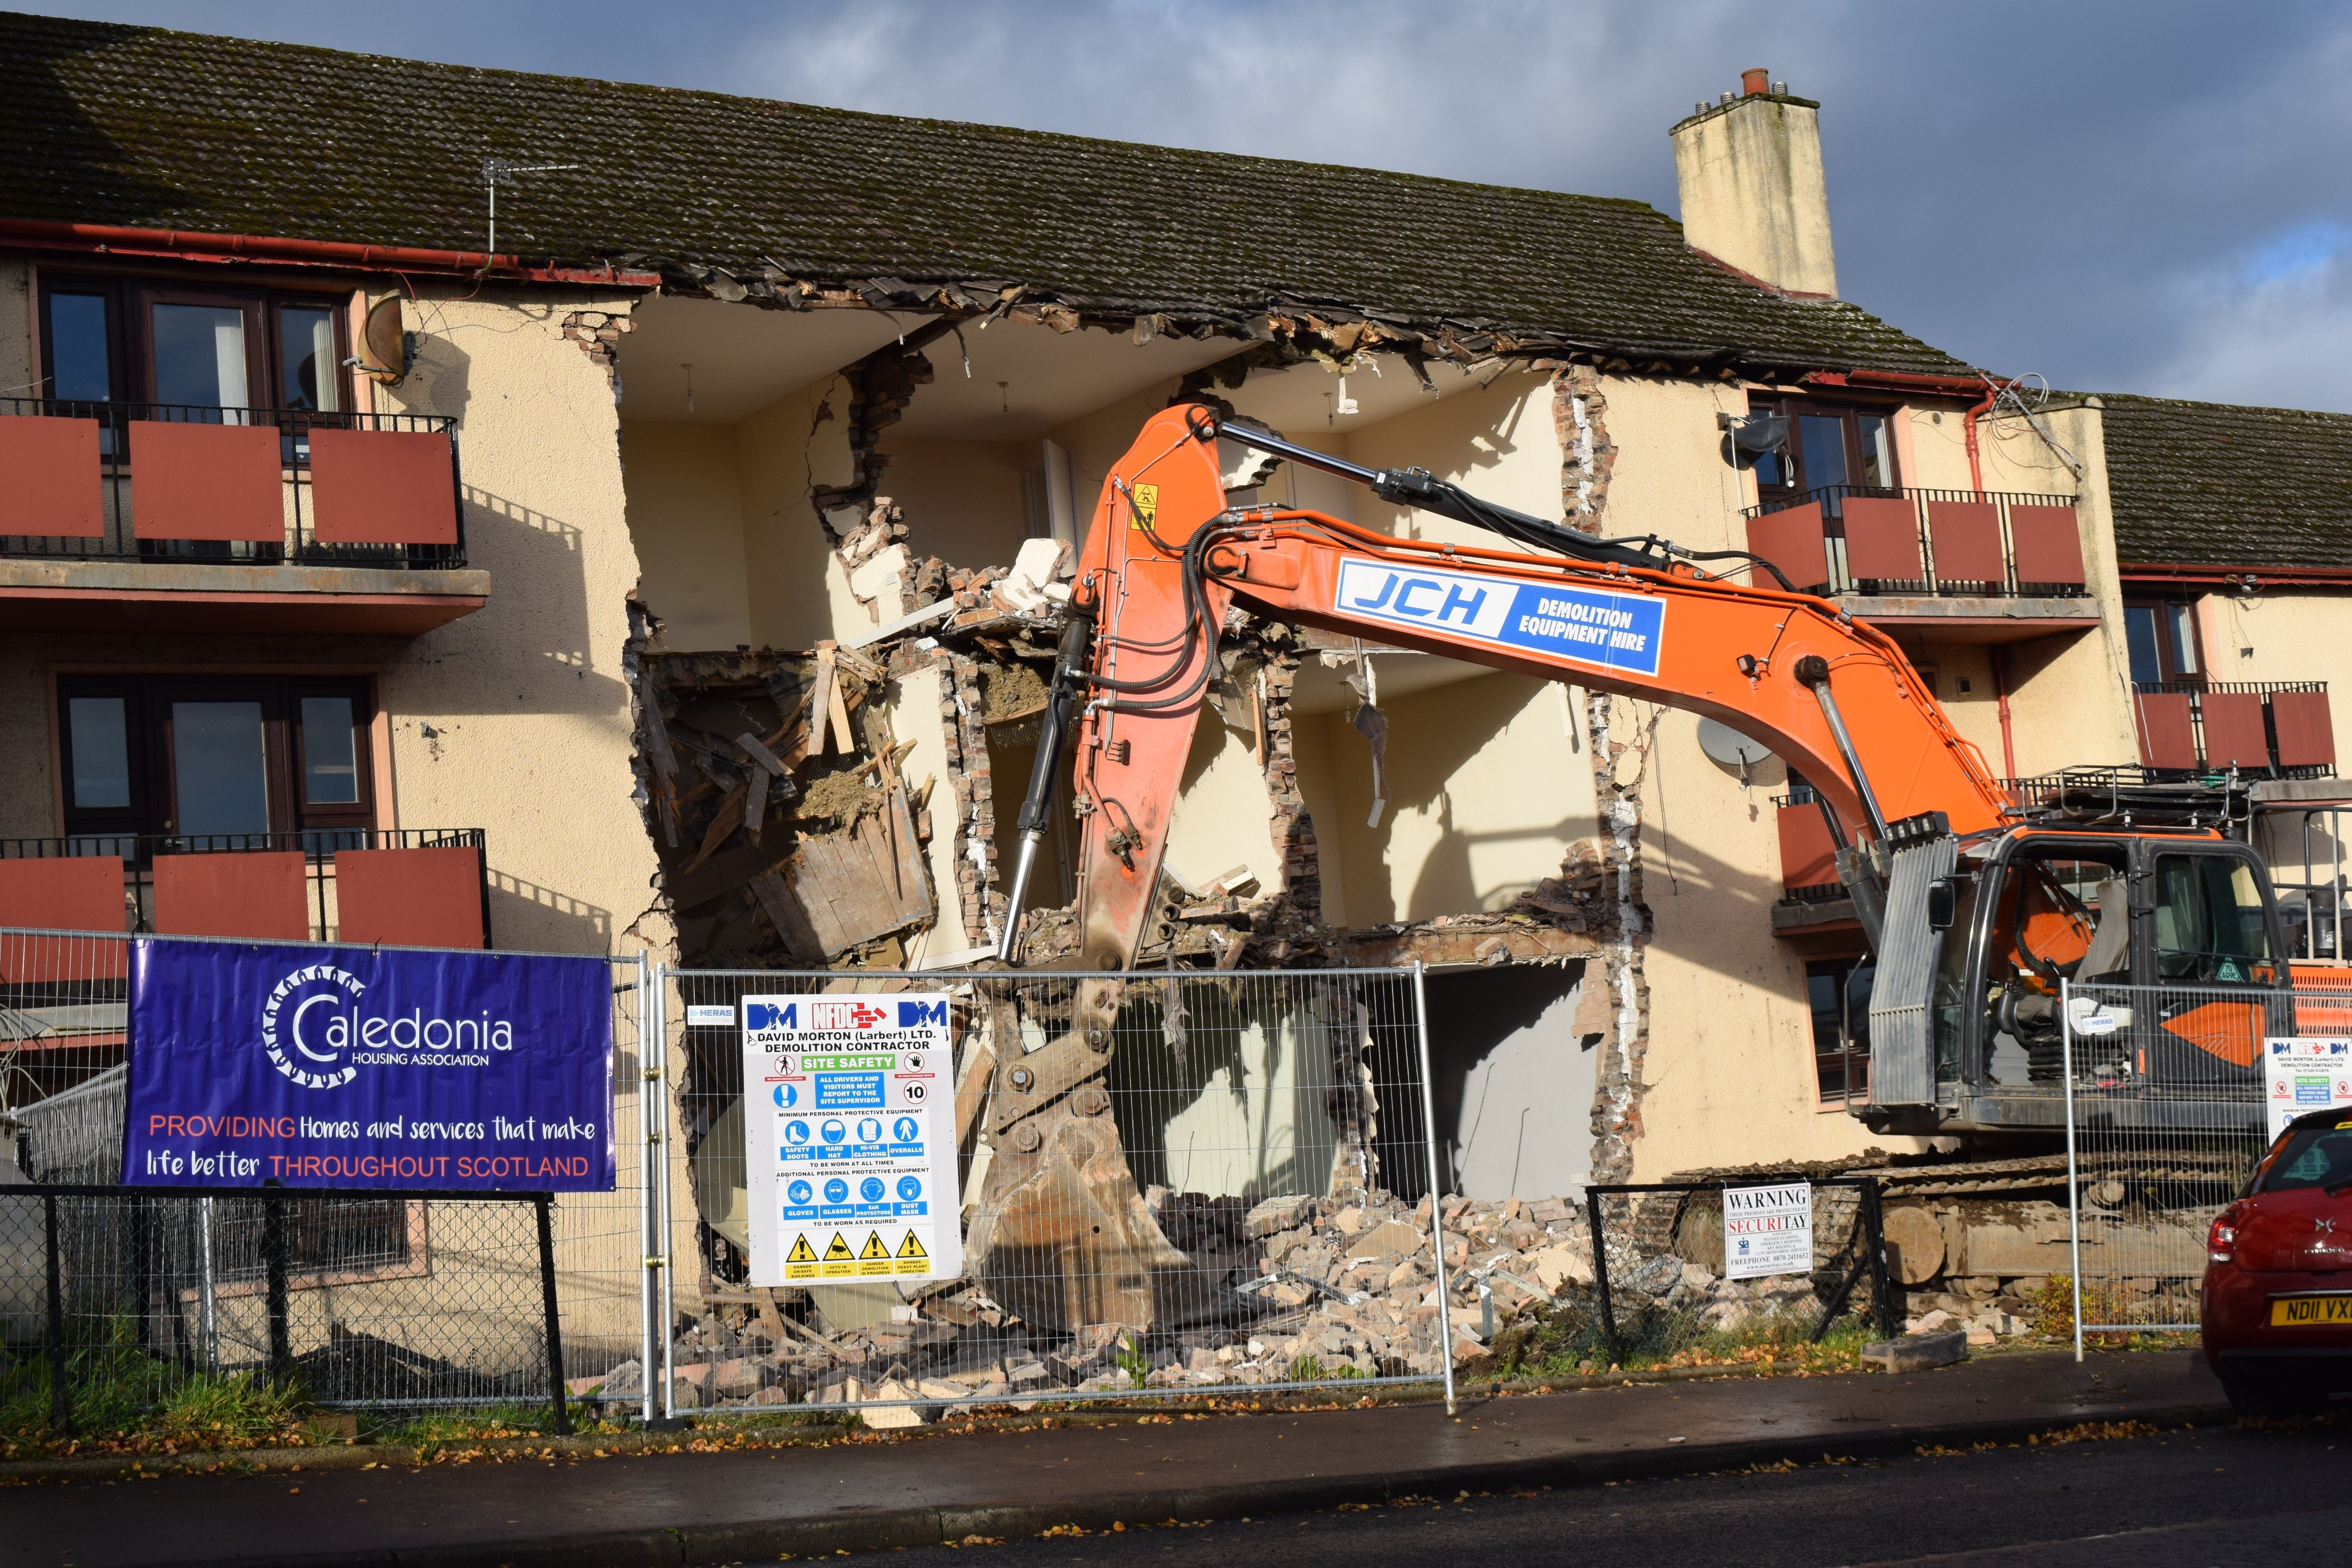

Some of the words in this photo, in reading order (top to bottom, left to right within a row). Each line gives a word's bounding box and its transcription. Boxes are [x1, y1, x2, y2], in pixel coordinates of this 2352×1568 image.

[1355, 573, 1487, 625] JCH
[1538, 599, 1633, 629] DEMOLITION
[1519, 616, 1607, 646] EQUIPMENT
[1610, 631, 1646, 652] HIRE
[747, 1003, 797, 1030] DM
[813, 1002, 858, 1029] NFDC
[898, 1001, 946, 1028] DM
[293, 994, 512, 1062] Caledonia
[757, 1032, 794, 1042] DAVID
[799, 1032, 851, 1041] MORTON
[856, 1031, 907, 1041] (Larbert)
[911, 1030, 936, 1039] LTD.
[765, 1043, 842, 1053] DEMOLITION
[846, 1042, 930, 1051] CONTRACTOR
[2273, 1043, 2291, 1054] DM
[2331, 1043, 2347, 1054] DM
[352, 1052, 410, 1064] HOUSING
[411, 1054, 489, 1066] ASSOCIATION
[804, 1058, 835, 1068] SITE
[840, 1057, 893, 1067] SAFETY
[906, 1086, 923, 1098] 10
[150, 1116, 295, 1138] PROVIDING
[301, 1118, 359, 1139] Homes
[367, 1116, 403, 1139] and
[411, 1120, 484, 1140] services
[492, 1117, 536, 1140] that
[542, 1117, 595, 1139] make
[148, 1149, 185, 1175] life
[191, 1149, 259, 1176] better
[269, 1156, 450, 1176] THROUGHOUT
[457, 1156, 588, 1176] SCOTLAND
[1729, 1189, 1805, 1209] WARNING
[1729, 1215, 1806, 1233] SECURITAY
[1731, 1256, 1770, 1265] FREEPHONE
[1747, 1261, 1794, 1269] www.securitay.co.uk
[2287, 1301, 2320, 1321] ND11
